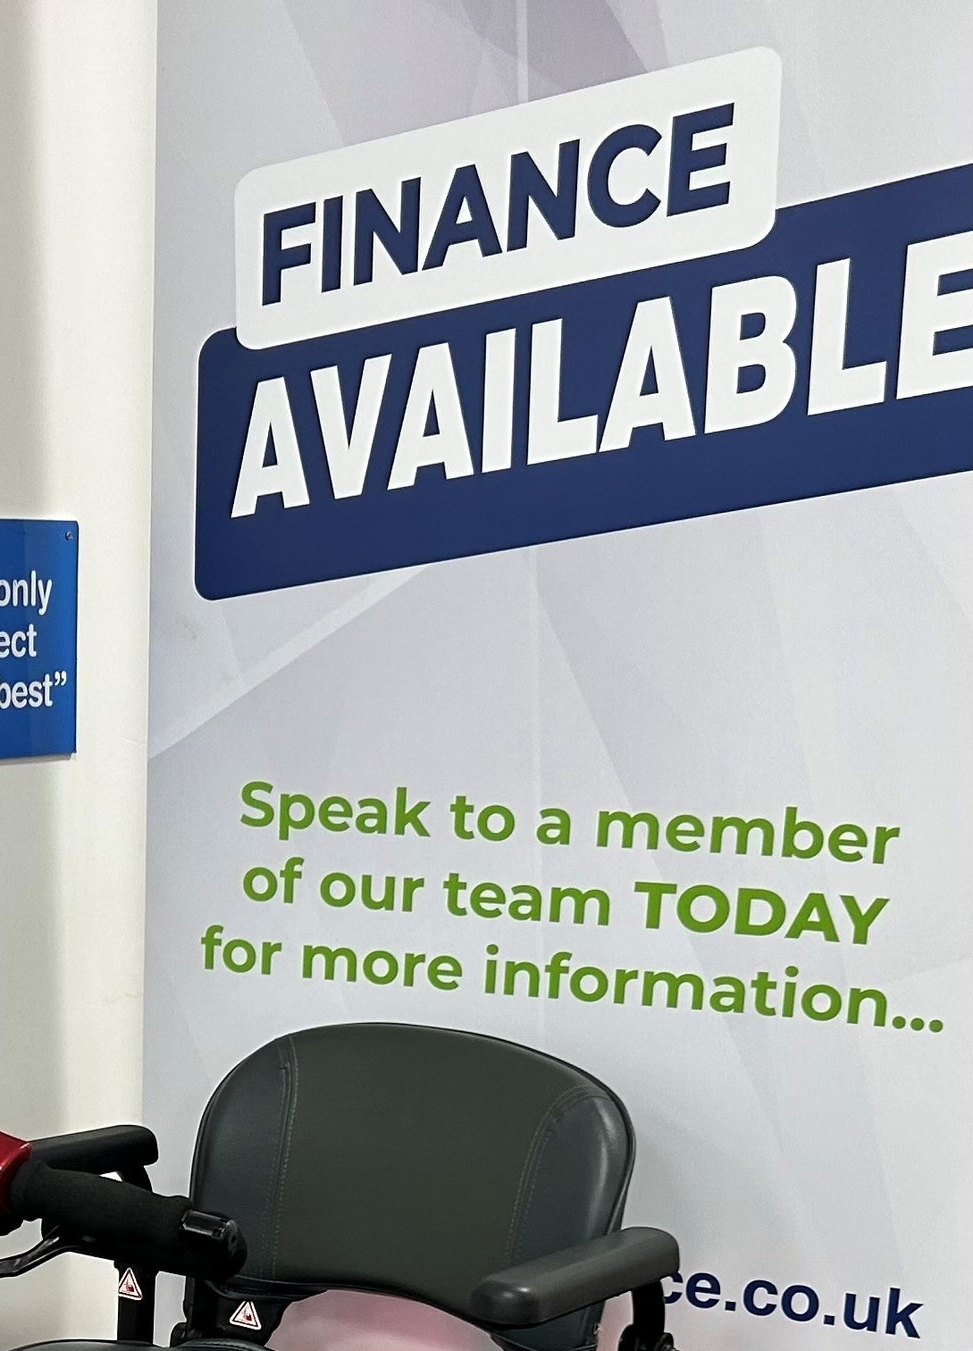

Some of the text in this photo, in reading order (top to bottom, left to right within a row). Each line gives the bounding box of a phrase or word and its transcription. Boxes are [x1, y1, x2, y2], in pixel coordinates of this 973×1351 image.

[261, 102, 735, 307] FINANCE
[230, 230, 973, 518] AVAILABLE
[241, 781, 900, 864] Speak to a member
[243, 856, 888, 945] of our team TODAY
[202, 924, 943, 1032] for more information...
